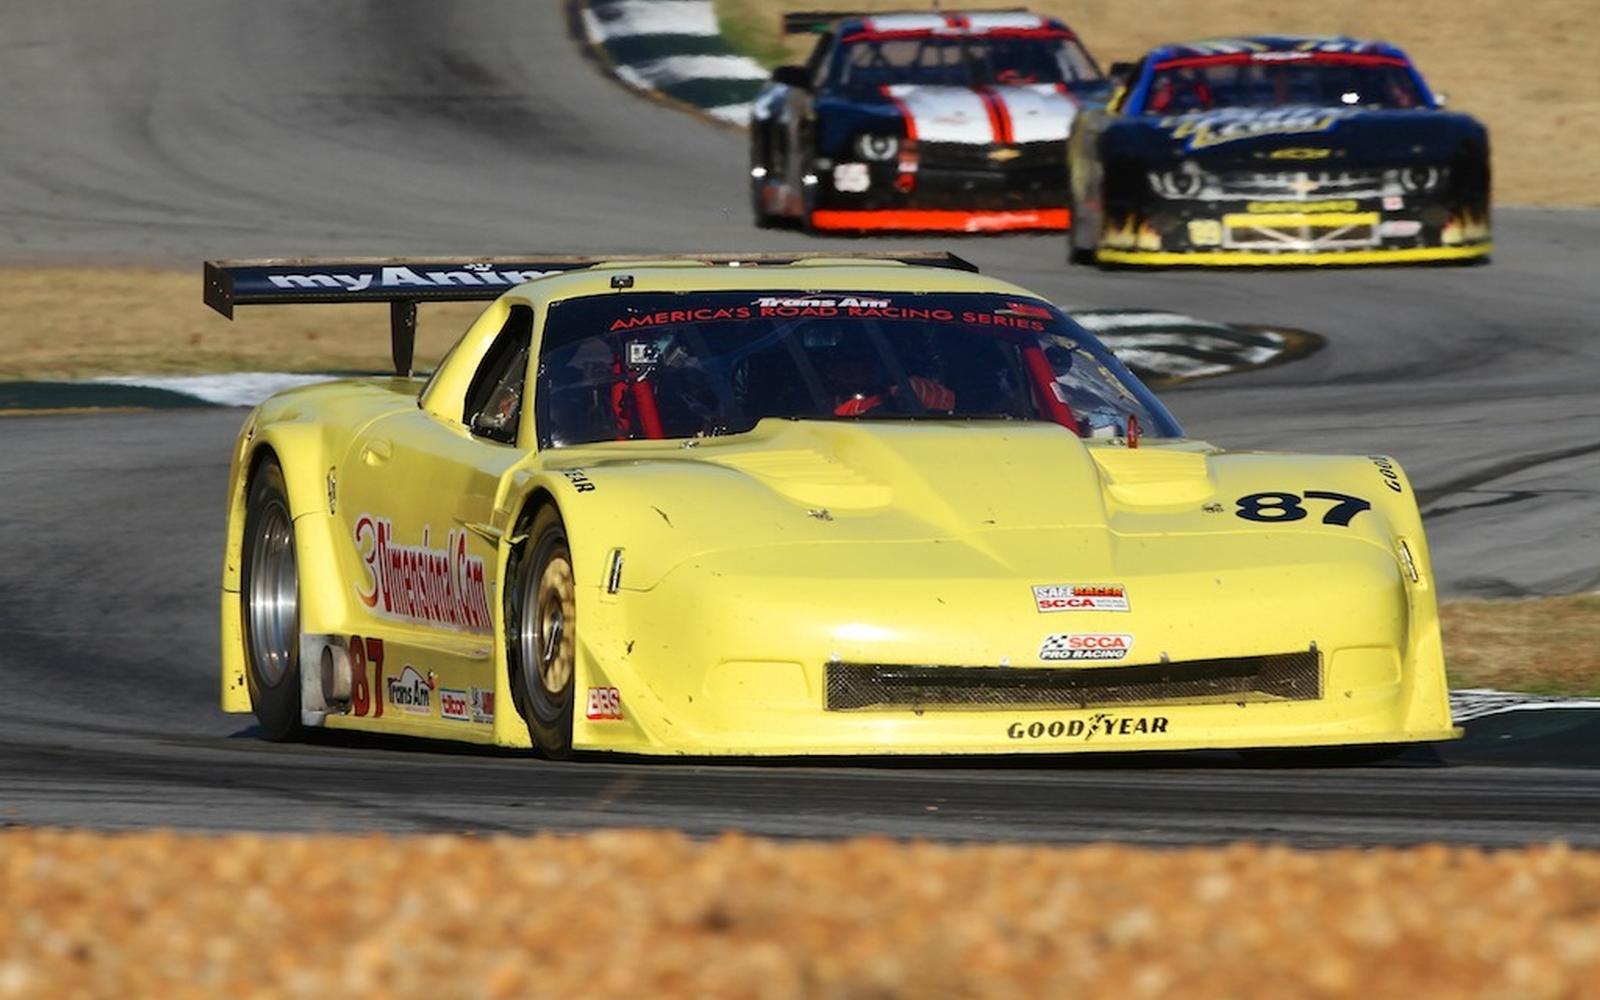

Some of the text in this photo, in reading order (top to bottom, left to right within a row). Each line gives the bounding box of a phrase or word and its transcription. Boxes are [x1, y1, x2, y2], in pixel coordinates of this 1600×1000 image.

[758, 297, 890, 308] Trans Am
[610, 306, 1045, 331] AMERICA'S ROAD RACING SERIES
[1235, 491, 1372, 527] 87
[1039, 598, 1096, 609] SCCA
[1041, 649, 1125, 659] PRO RACING
[1068, 636, 1126, 648] SCCA
[350, 635, 384, 718] 87
[387, 677, 430, 707] Trans Am
[586, 686, 624, 718] BBS
